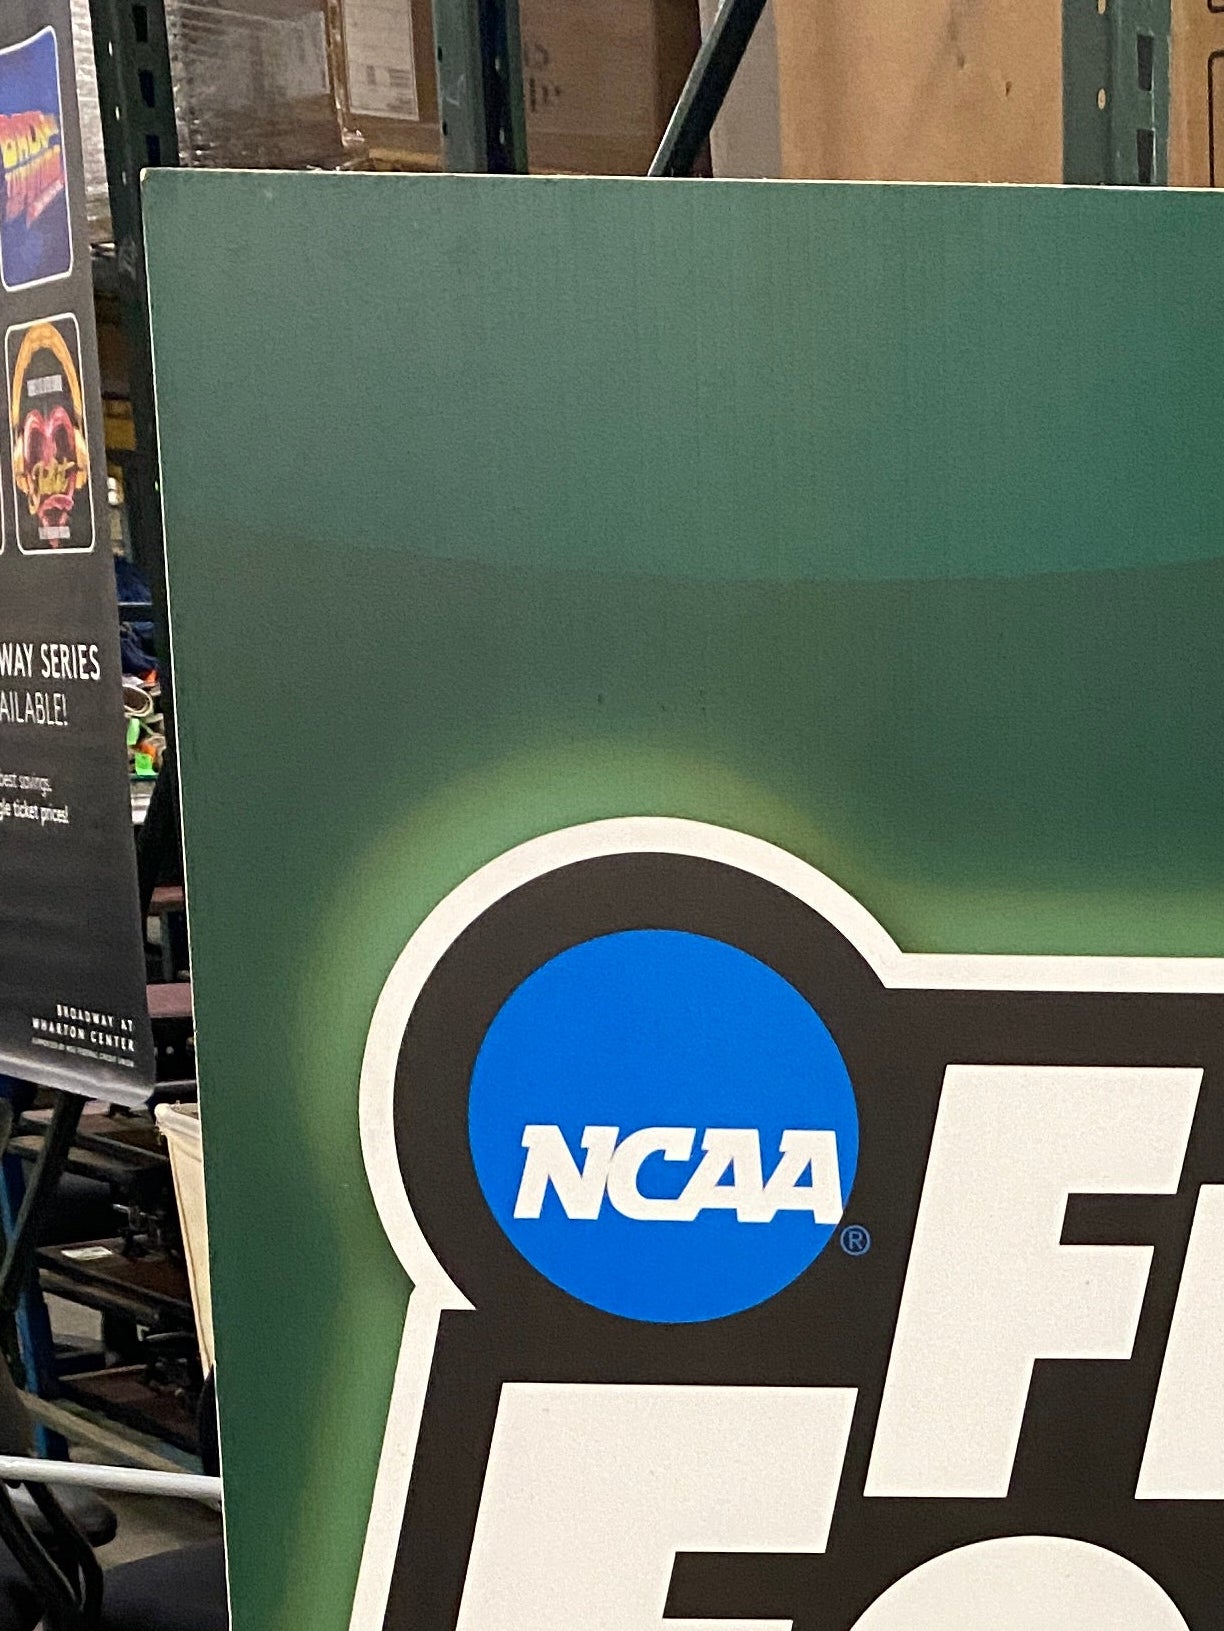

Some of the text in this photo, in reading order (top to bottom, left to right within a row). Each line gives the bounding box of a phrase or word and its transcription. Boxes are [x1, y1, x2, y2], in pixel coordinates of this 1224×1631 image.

[41, 643, 101, 680] SERIES
[12, 799, 39, 820] ticket
[32, 1018, 135, 1052] WHARTON CENTER
[57, 1004, 133, 1032] BROADWAY AT
[513, 1124, 844, 1225] NCAA
